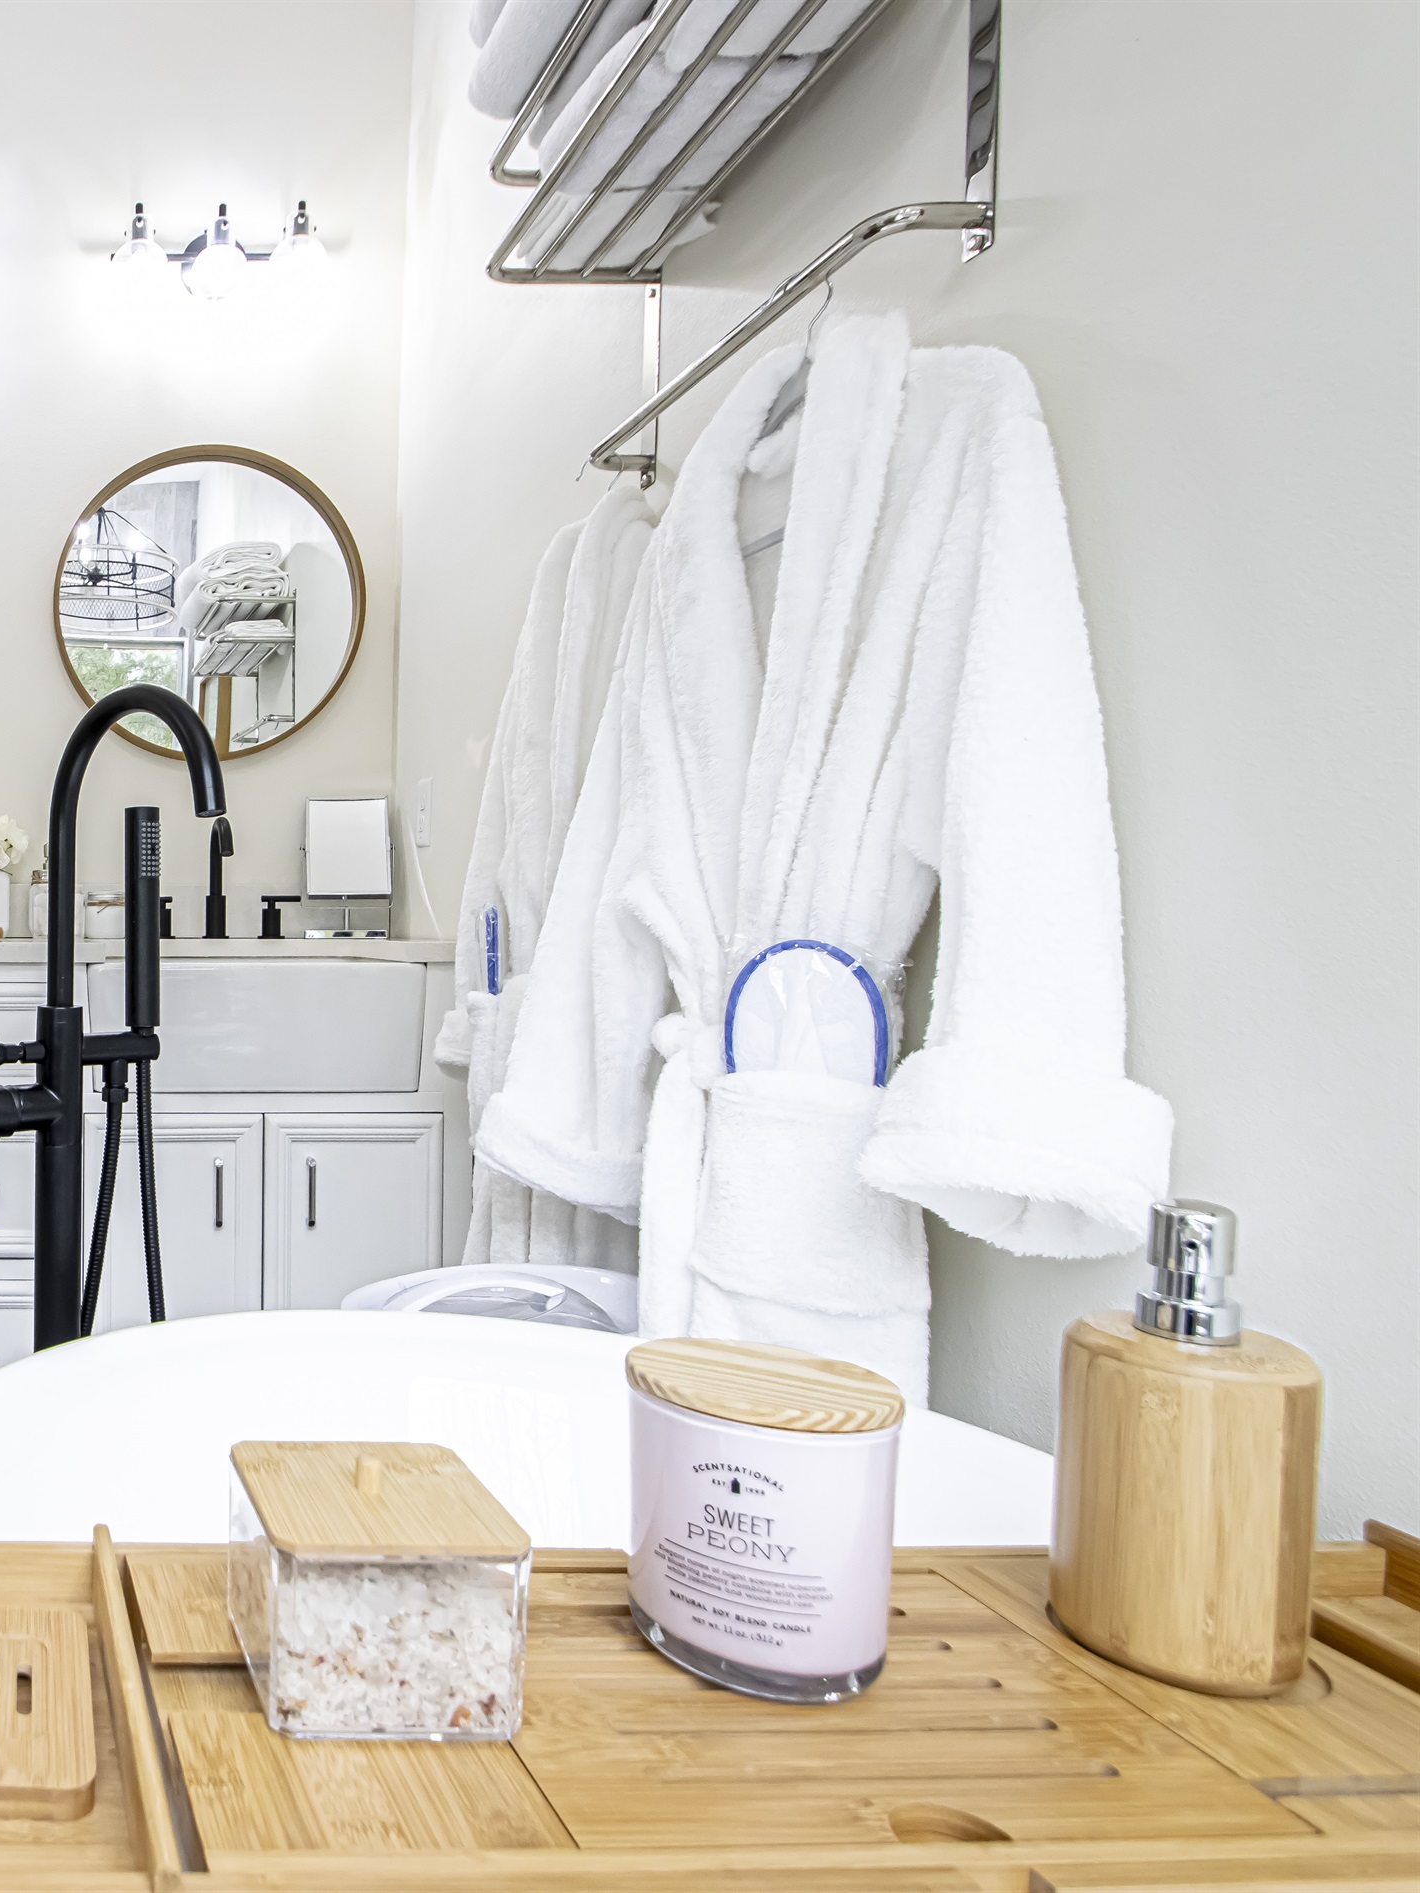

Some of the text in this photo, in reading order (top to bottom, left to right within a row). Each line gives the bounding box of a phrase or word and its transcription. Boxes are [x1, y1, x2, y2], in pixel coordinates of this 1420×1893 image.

[692, 1462, 784, 1492] SCENTSATIONAL
[703, 1503, 775, 1537] SWEET
[687, 1521, 796, 1563] PEONY
[667, 1556, 700, 1576] blushing
[702, 1571, 729, 1585] peony
[731, 1581, 772, 1594] combine
[774, 1589, 795, 1598] with
[688, 1573, 722, 1591] jasmine
[724, 1587, 742, 1596] and
[745, 1593, 791, 1606] woodland
[722, 1570, 746, 1581] night
[749, 1576, 785, 1589] scented
[669, 1589, 812, 1633] NATURAL SOY BLEND CANDLE
[691, 1615, 706, 1625] NET
